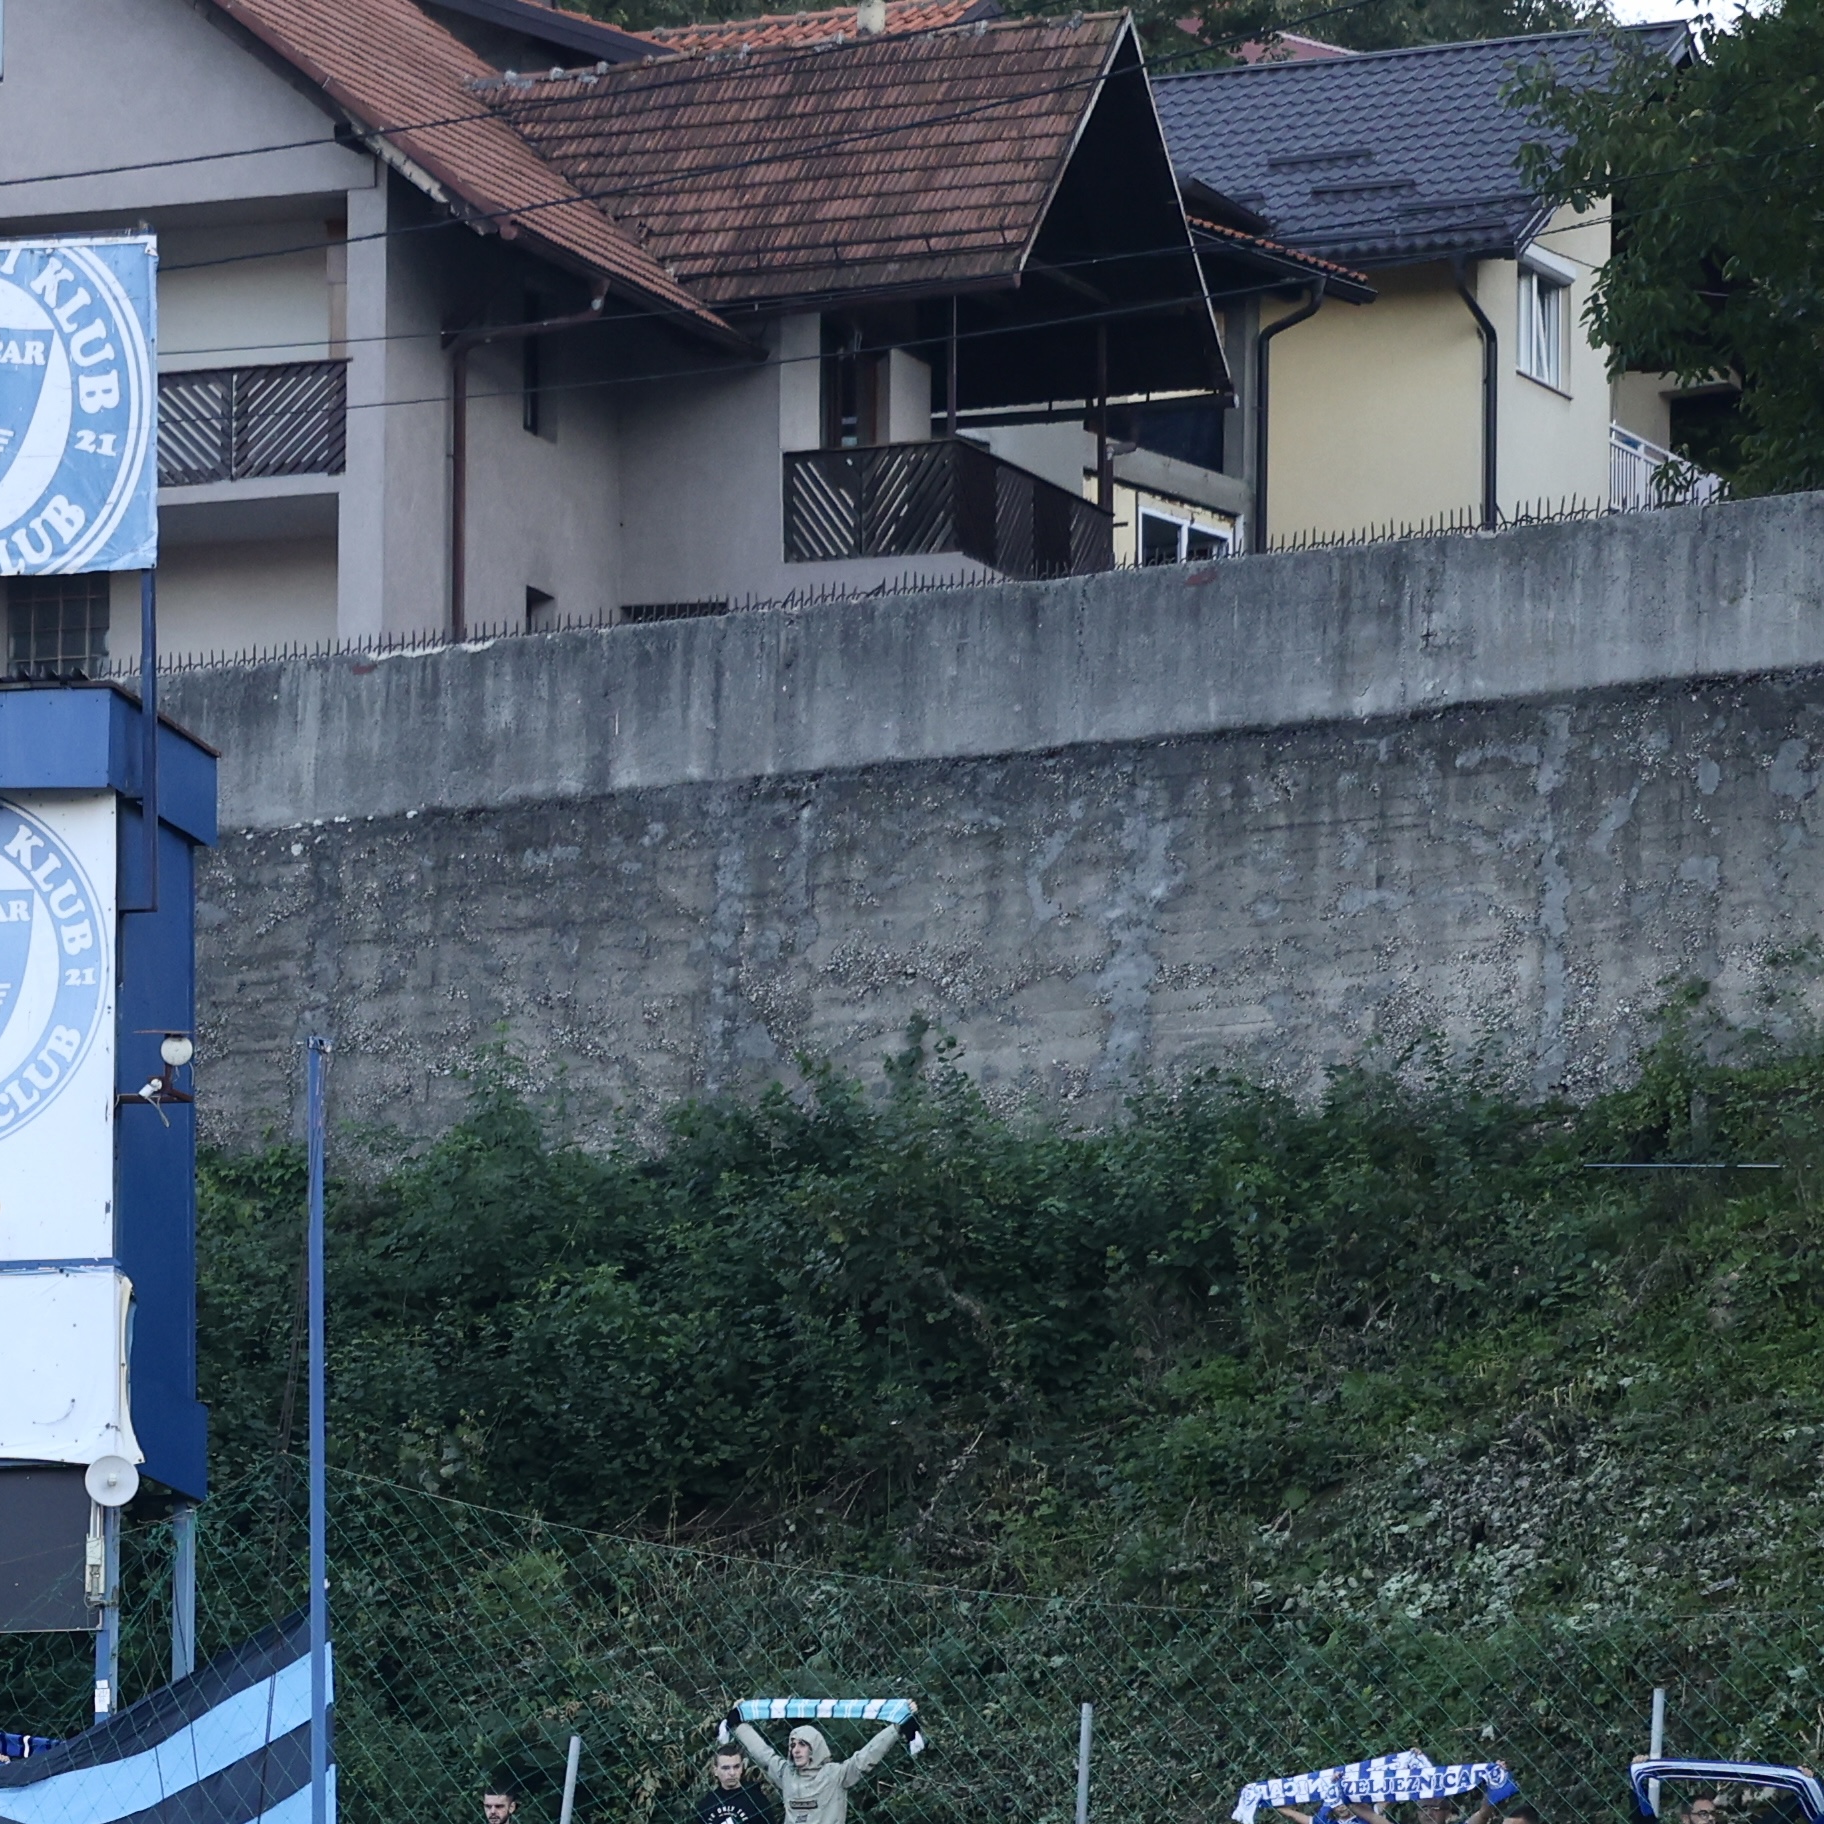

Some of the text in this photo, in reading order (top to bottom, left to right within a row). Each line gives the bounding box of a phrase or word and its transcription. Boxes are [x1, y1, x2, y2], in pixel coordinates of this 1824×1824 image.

[31, 250, 121, 414] KLUB
[75, 429, 118, 458] 21
[4, 823, 94, 956] KLUB
[64, 967, 97, 987] 21
